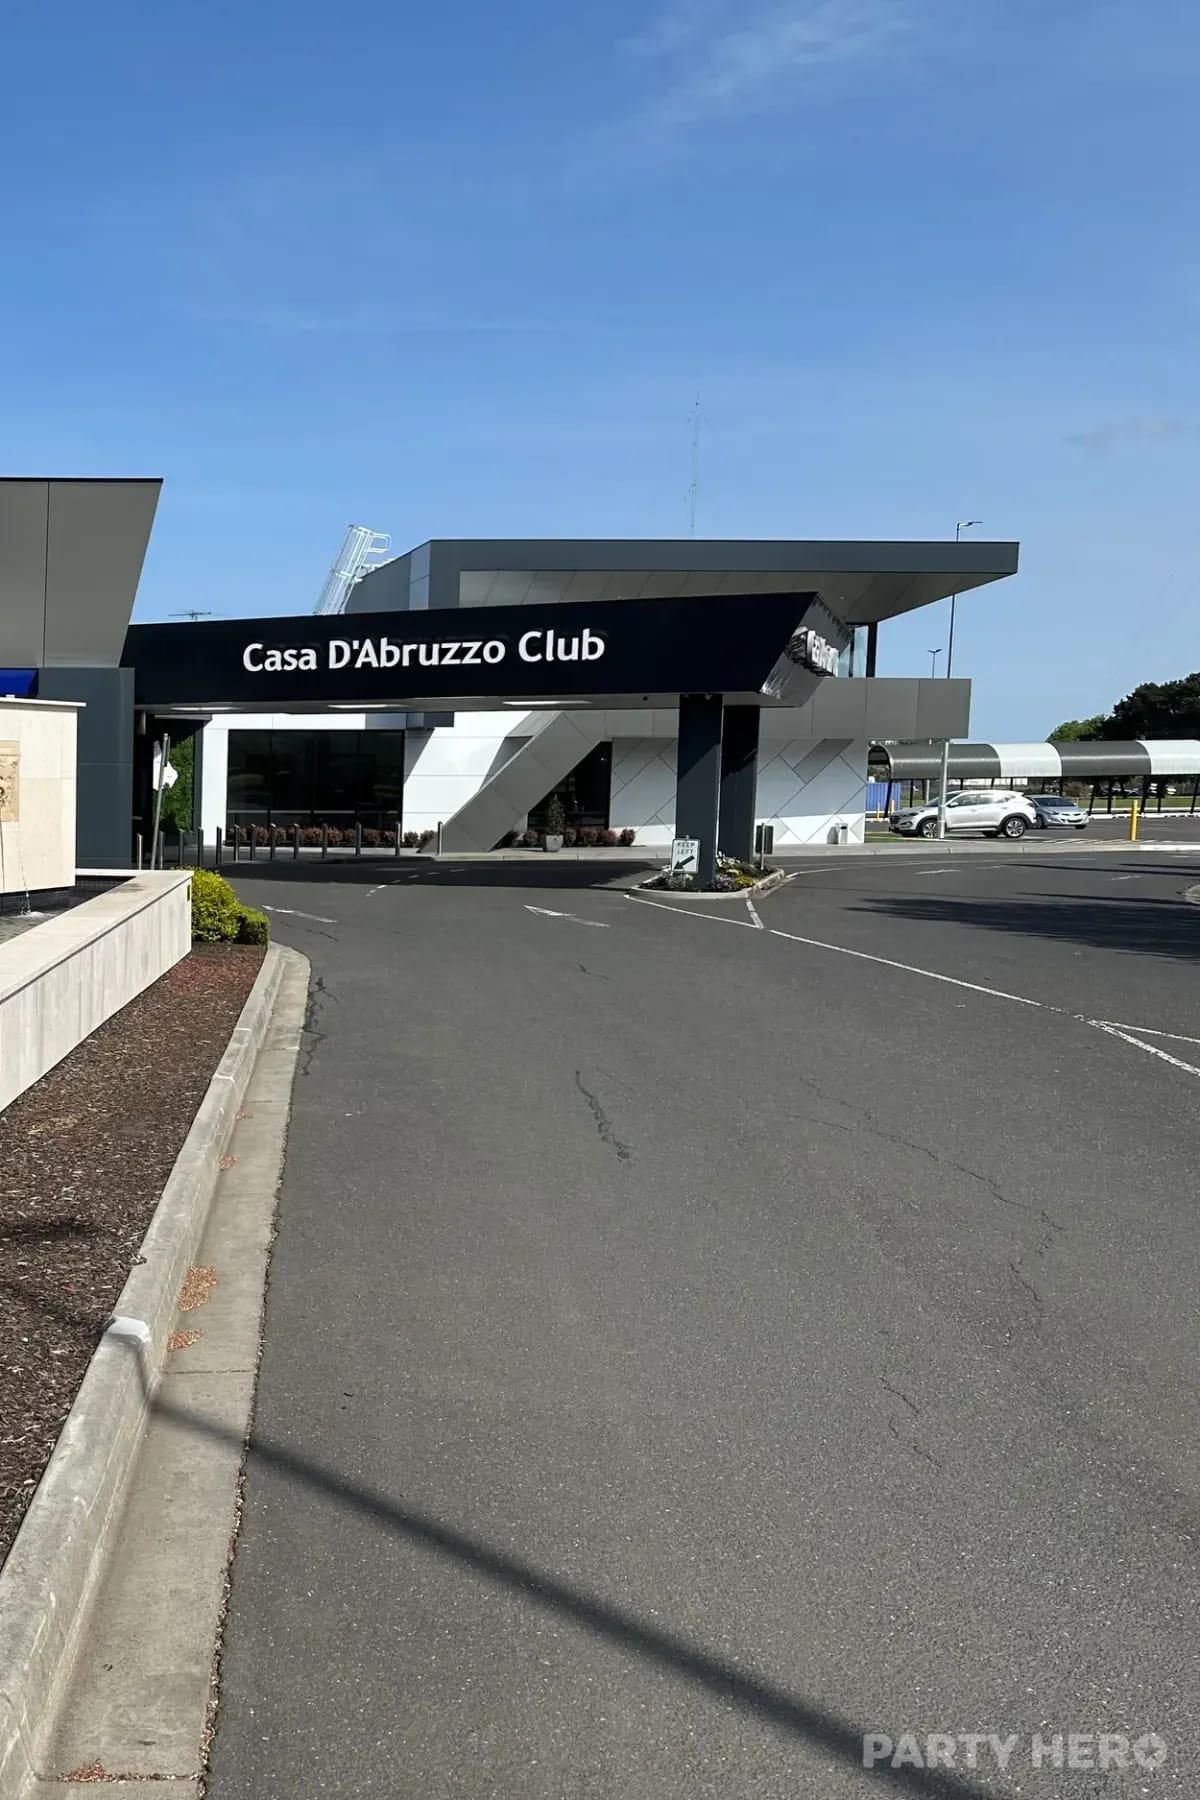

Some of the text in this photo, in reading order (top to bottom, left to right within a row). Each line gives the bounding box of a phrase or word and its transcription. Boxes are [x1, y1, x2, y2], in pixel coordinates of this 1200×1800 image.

[242, 628, 605, 672] Casa D'Abruzzo Club
